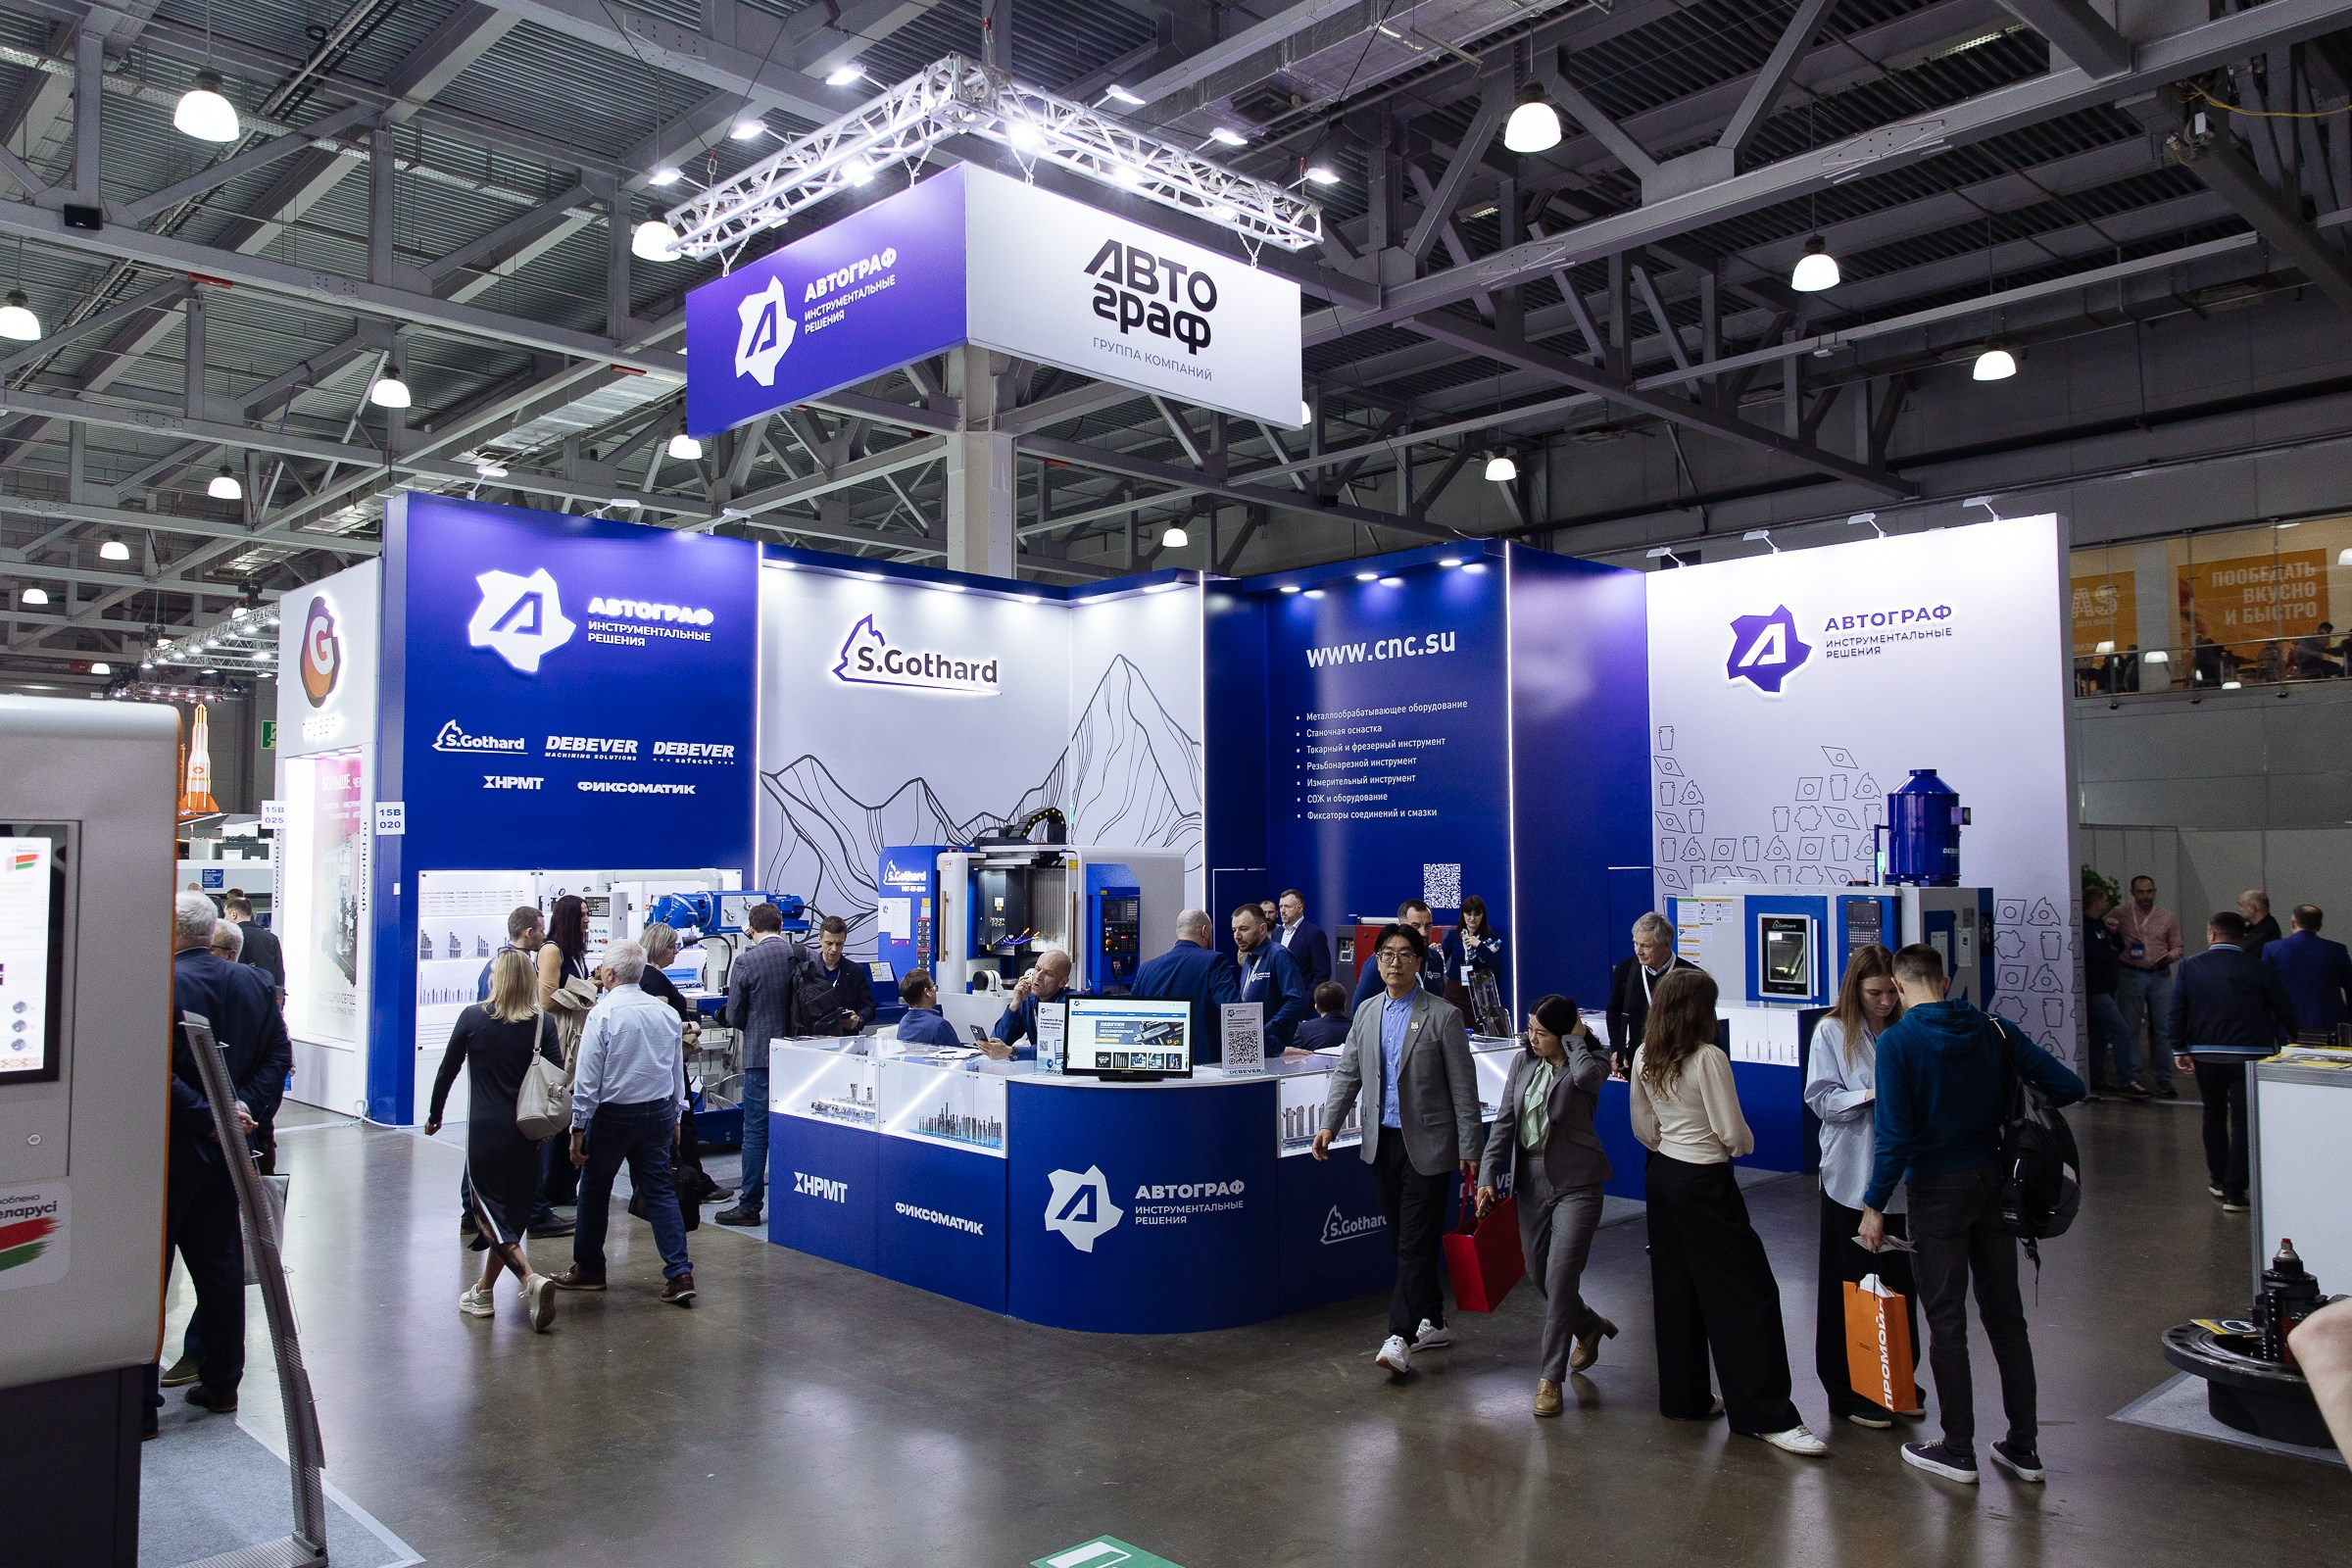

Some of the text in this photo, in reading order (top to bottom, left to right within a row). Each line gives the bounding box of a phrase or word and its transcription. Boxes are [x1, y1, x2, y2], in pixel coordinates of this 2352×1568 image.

[805, 247, 897, 303] АВТОГРАФ
[1084, 238, 1217, 313] АВТО
[805, 274, 896, 321] ИНСТРУМЕНТАЛЬНЫЕ
[805, 310, 845, 334] РЕШЕНИЯ
[1093, 337, 1212, 381] ГРУППА КОМПАНИЙ
[2212, 561, 2315, 588] ПООБЕДАТЬ
[2243, 582, 2317, 605] ВКУСНО
[588, 597, 714, 626] АВТОГРАФ
[1825, 605, 1952, 632] АВТОГРАФ
[2226, 602, 2318, 625] И БЫСТРО
[588, 621, 711, 642] ИНСТРУМЕНТАЛЬНЫЕ
[588, 633, 646, 647] РЕШЕНИЯ
[1826, 627, 1952, 648] ИНСТРУМЕНТАЛЬНЫЕ
[1306, 631, 1455, 668] www.cnc.su
[1826, 646, 1882, 659] РЕШЕНИЯ
[858, 646, 998, 683] S.Gothard
[1306, 700, 1468, 721] Металлообрабатывающее оборудование
[446, 734, 525, 750] S.Gothard
[1306, 725, 1383, 738] Станочная оснастка
[545, 735, 638, 754] DEBEVER
[653, 741, 734, 759] DEBEVER
[1306, 743, 1344, 755] Токарный
[1351, 739, 1396, 753] фрезерный
[1398, 737, 1446, 749] инструмент
[1306, 757, 1417, 771] Резьбонарезной инструмент
[577, 781, 696, 795] ФИКСОМАТИК
[1306, 774, 1416, 788] Измерительный инструмент
[1307, 794, 1325, 804] СОЖ
[1333, 793, 1388, 804] оборудование
[1307, 810, 1349, 820] Фиксаторы
[1350, 808, 1398, 819] соединений
[1407, 808, 1438, 817] смазки
[1135, 1179, 1246, 1200] АВТОГРАФ
[1135, 1200, 1244, 1214] ИНСТРУМЕНТАЛЬНЫЕ
[895, 1201, 984, 1236] ФИКСОМАТИК
[1135, 1215, 1187, 1225] РЕШЕНИЯ
